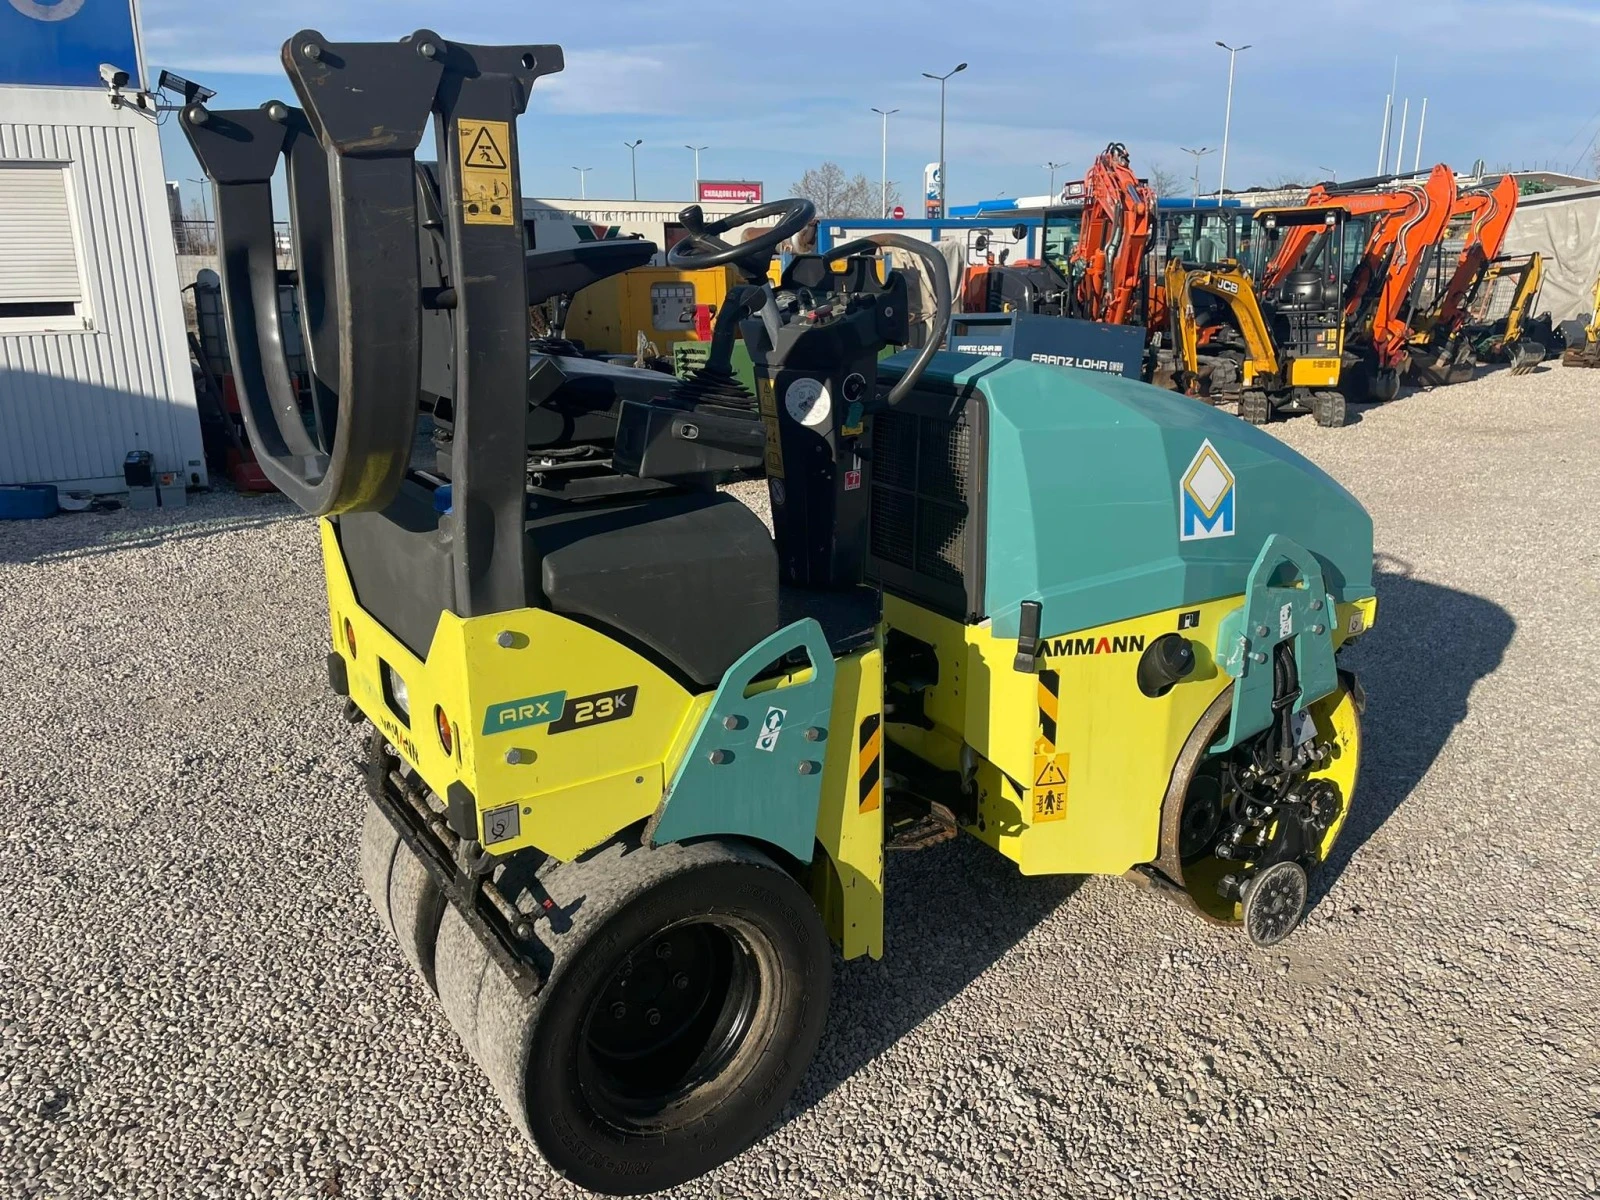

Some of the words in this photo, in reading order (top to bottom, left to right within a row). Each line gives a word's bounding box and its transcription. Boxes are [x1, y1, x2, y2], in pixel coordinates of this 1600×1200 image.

[1217, 278, 1238, 293] JCB
[1031, 353, 1073, 366] FRANZ
[1075, 358, 1108, 370] LOHR
[1035, 635, 1145, 657] AMMANN
[499, 701, 550, 724] ARX
